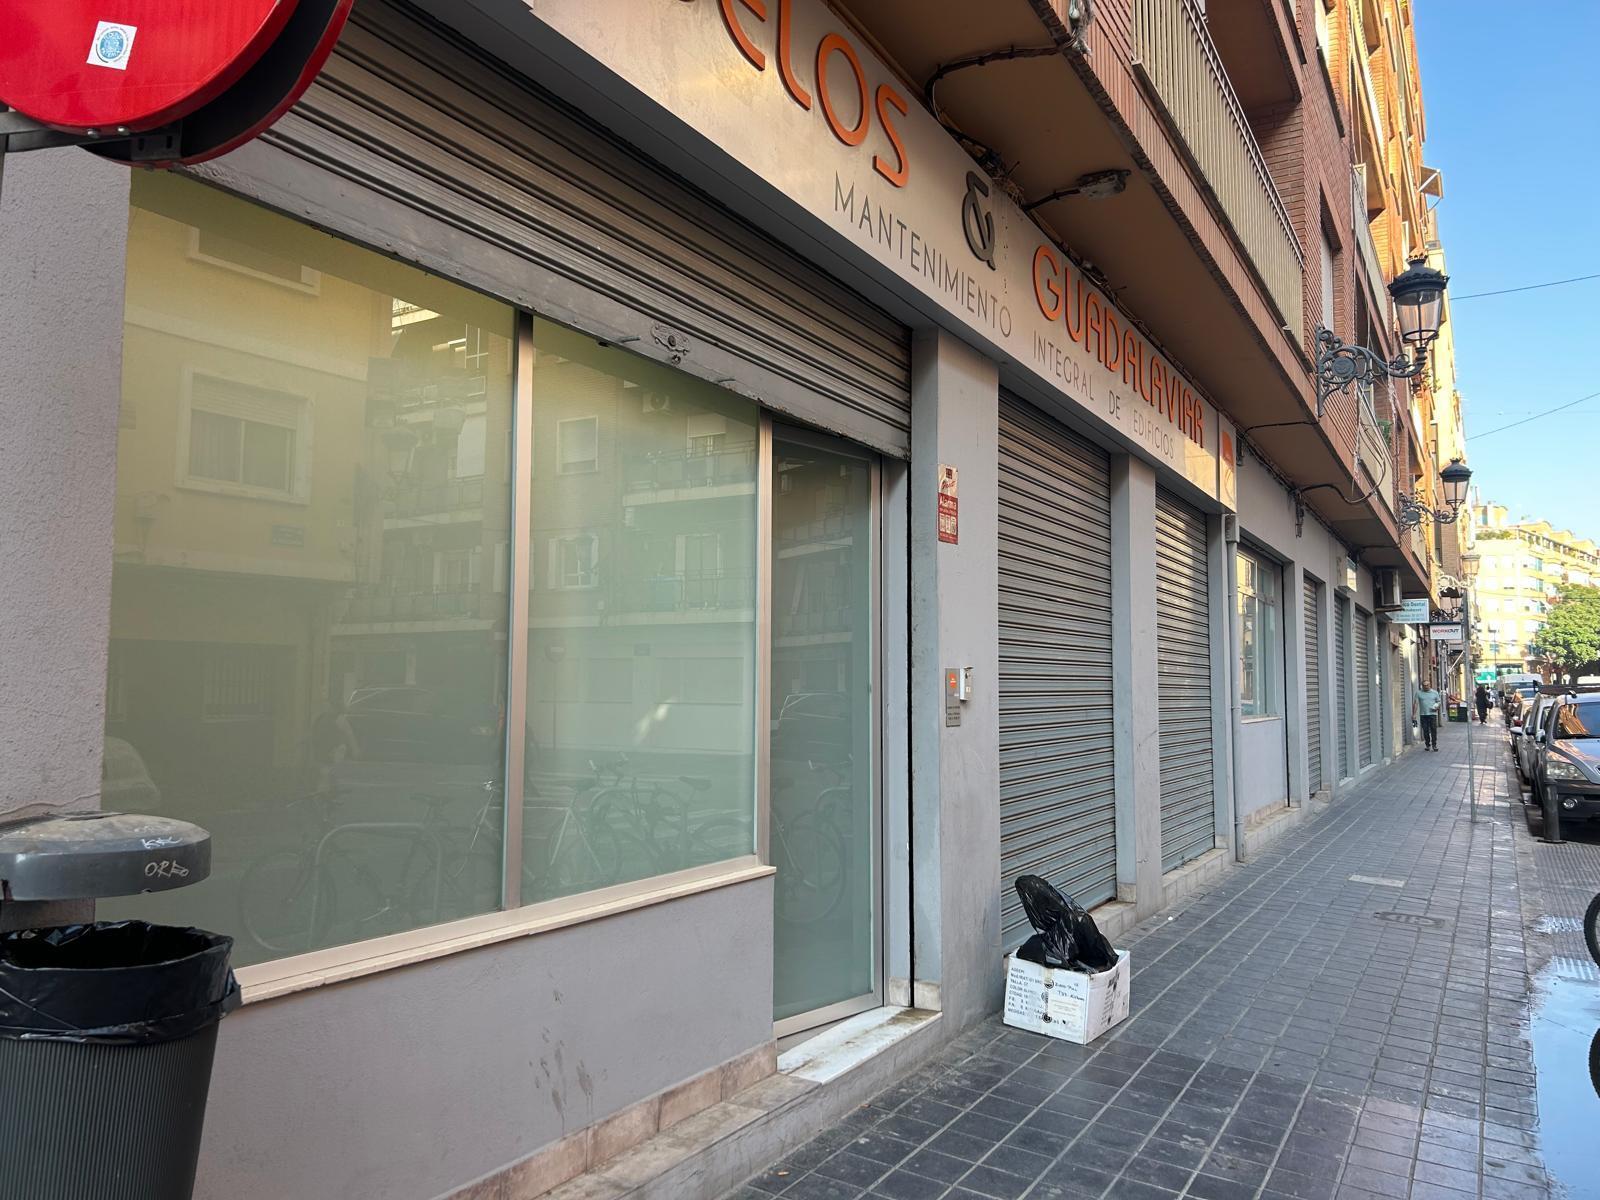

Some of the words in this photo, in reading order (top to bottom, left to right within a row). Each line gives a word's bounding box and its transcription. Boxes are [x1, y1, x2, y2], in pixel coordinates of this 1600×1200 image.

[716, 0, 909, 188] ELOS
[961, 170, 996, 271] &
[1033, 245, 1204, 449] GUADALAVIAR
[834, 170, 1012, 338] MANTENIMIENTO
[1033, 330, 1095, 401] INTEGRAL
[1108, 390, 1121, 421] DE
[1133, 409, 1175, 460] EDIFICIOS
